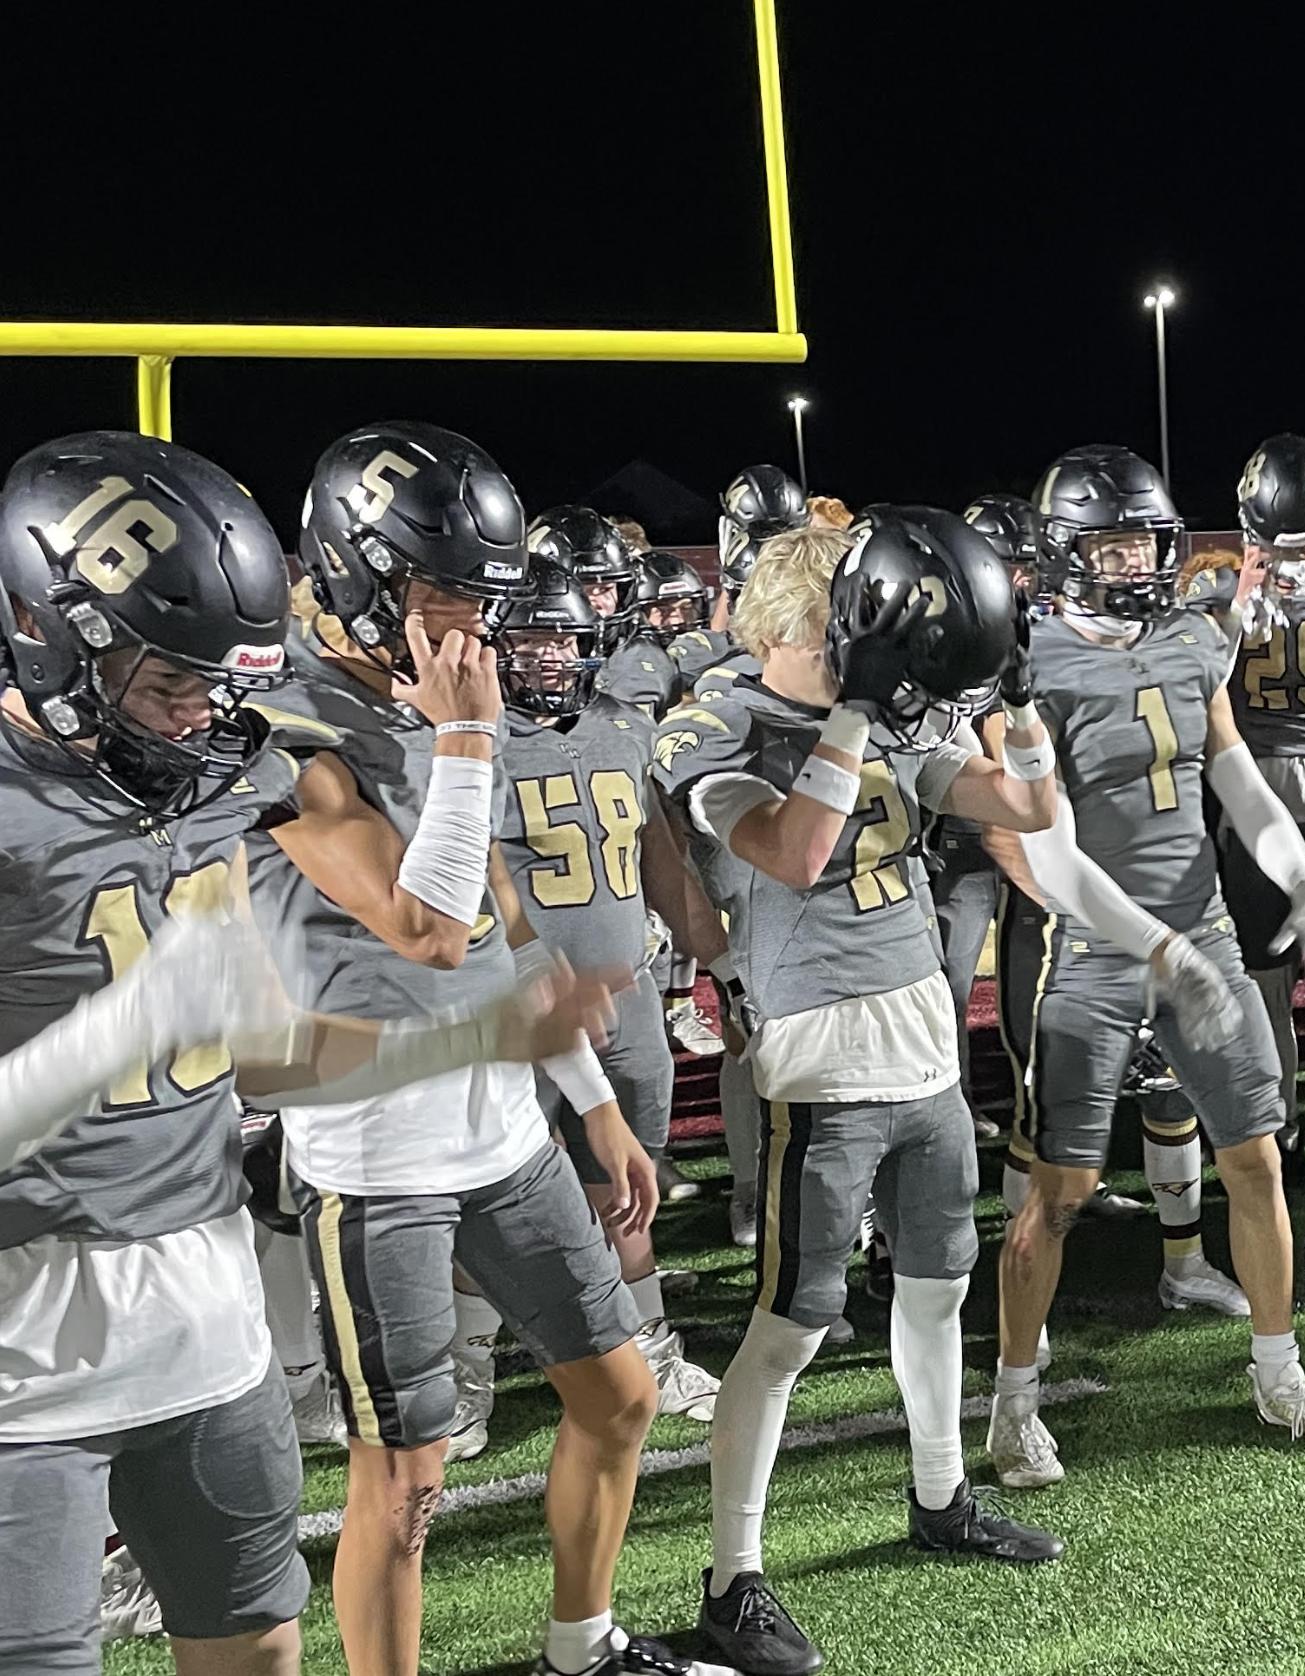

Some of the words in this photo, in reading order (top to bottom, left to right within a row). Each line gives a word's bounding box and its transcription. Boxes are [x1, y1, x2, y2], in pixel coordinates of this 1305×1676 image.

[50, 475, 178, 595] 16
[346, 450, 420, 524] 5
[483, 561, 524, 580] Riddell
[1133, 683, 1183, 814] 1
[515, 768, 646, 908] 58
[849, 758, 913, 913] 2
